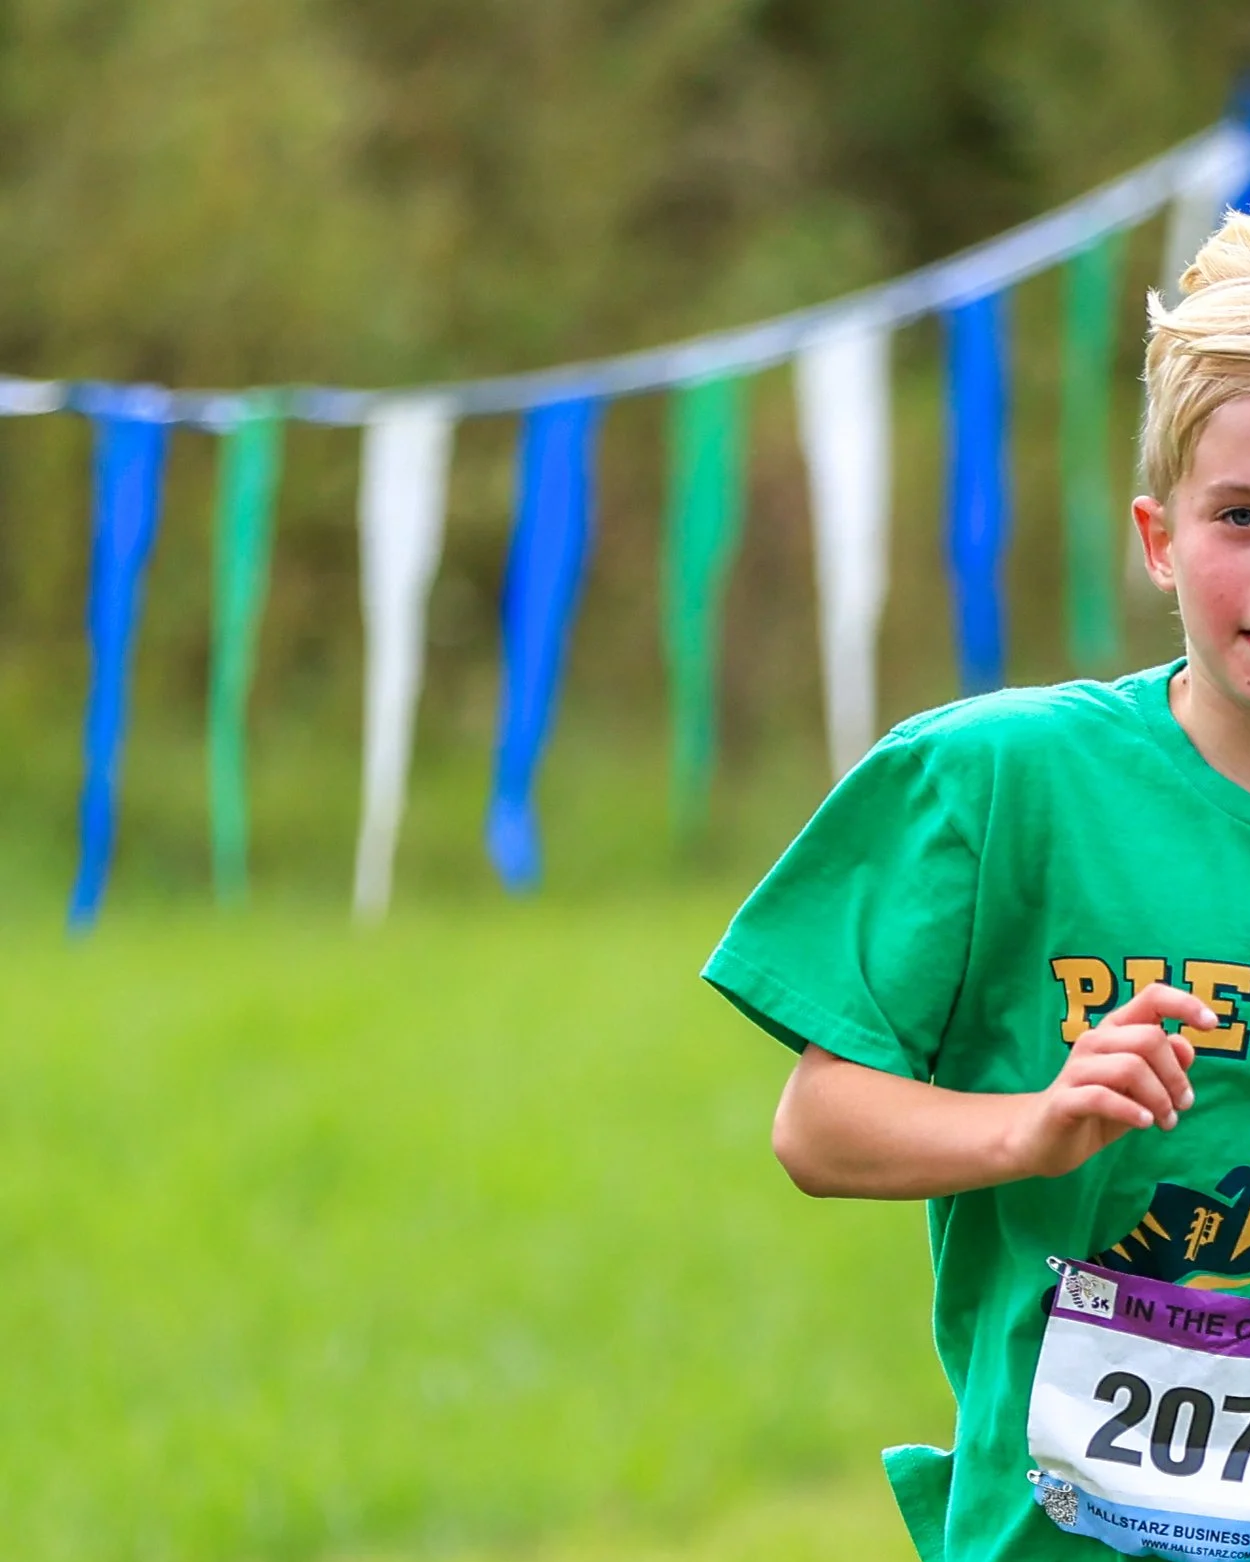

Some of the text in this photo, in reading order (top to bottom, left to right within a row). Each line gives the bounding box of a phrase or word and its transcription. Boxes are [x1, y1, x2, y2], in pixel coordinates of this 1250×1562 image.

[1184, 1207, 1224, 1261] P
[1091, 1296, 1110, 1311] 5K
[1125, 1295, 1155, 1323] IN
[1165, 1304, 1225, 1337] THE
[1086, 1502, 1170, 1537] HALLSTARZ
[1173, 1524, 1250, 1546] BUSINESS
